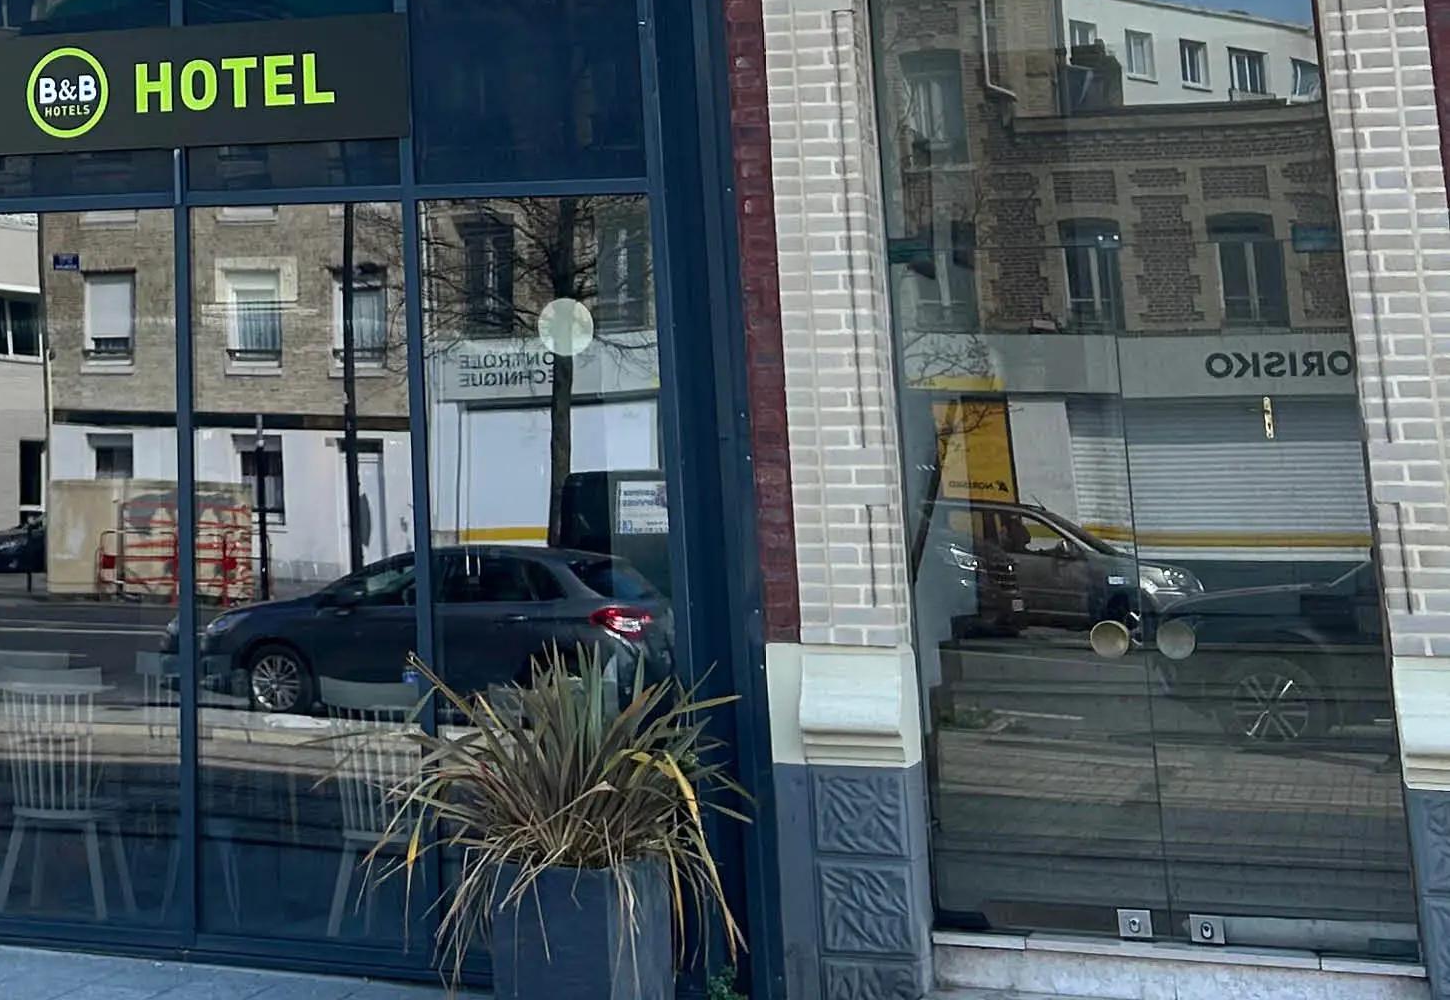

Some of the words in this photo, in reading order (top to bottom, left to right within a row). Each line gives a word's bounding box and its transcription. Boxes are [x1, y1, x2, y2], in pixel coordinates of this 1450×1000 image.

[39, 75, 96, 104] B&B
[135, 53, 335, 113] HOTEL
[45, 105, 90, 117] HOTELS
